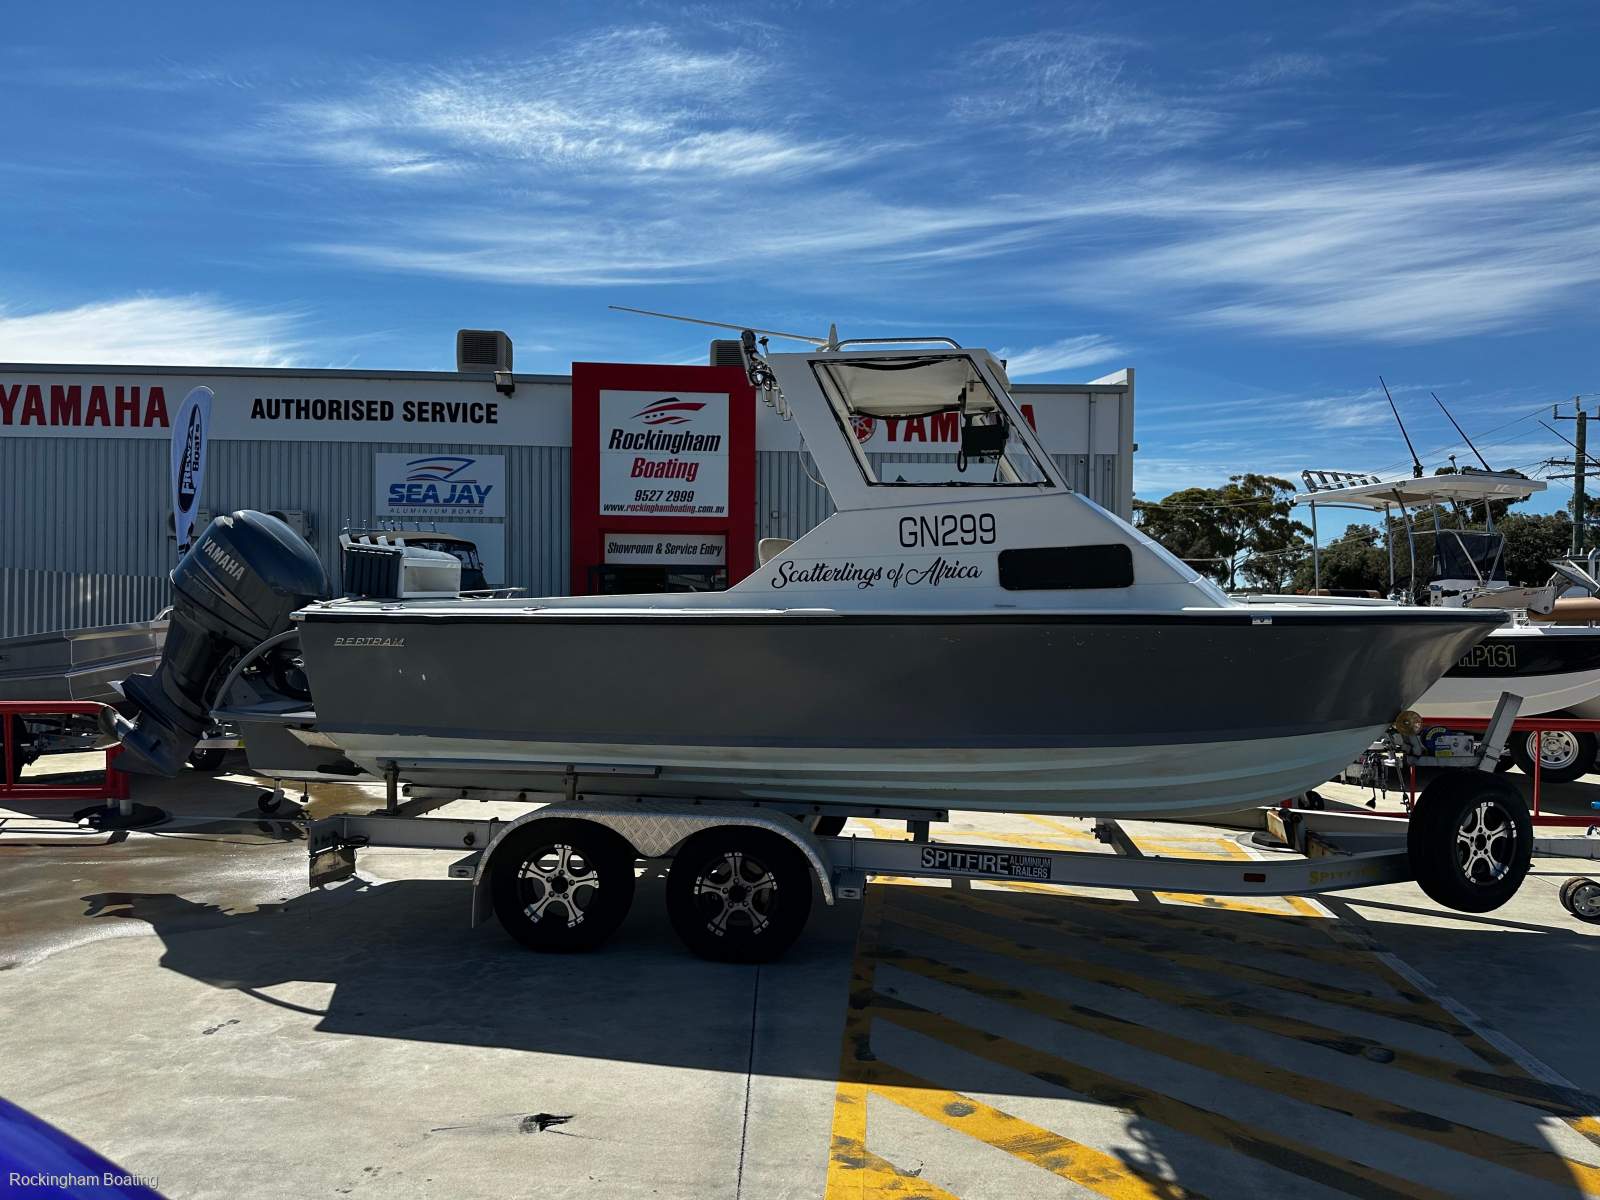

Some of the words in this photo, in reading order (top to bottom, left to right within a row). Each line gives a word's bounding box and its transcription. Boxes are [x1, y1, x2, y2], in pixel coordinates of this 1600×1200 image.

[0, 384, 170, 428] YAMAHA
[251, 398, 394, 422] AUTHORISED
[402, 401, 498, 424] SERVICE
[885, 404, 1037, 442] YAMA
[608, 428, 721, 455] Rockingham
[630, 457, 699, 482] Boating
[388, 483, 442, 504] SEA
[442, 484, 493, 505] JAY
[634, 489, 663, 502] 9527
[665, 490, 695, 503] 2999
[389, 507, 448, 515] ALUMINIUM
[452, 507, 484, 515] BOATS
[603, 503, 724, 514] www.rockinghamboating.com.au
[899, 513, 996, 548] GN299
[201, 536, 245, 582] YAMAHA
[607, 542, 653, 554] Showroom
[655, 542, 662, 554] &
[664, 542, 697, 555] Service
[699, 543, 723, 557] Entry
[771, 560, 883, 589] Scatterlings
[887, 563, 905, 588] of
[905, 557, 983, 587] Africa
[922, 847, 1009, 875] SPITFIRE
[1009, 855, 1051, 867] ALUMINIUM
[1011, 865, 1048, 878] TRAILERS
